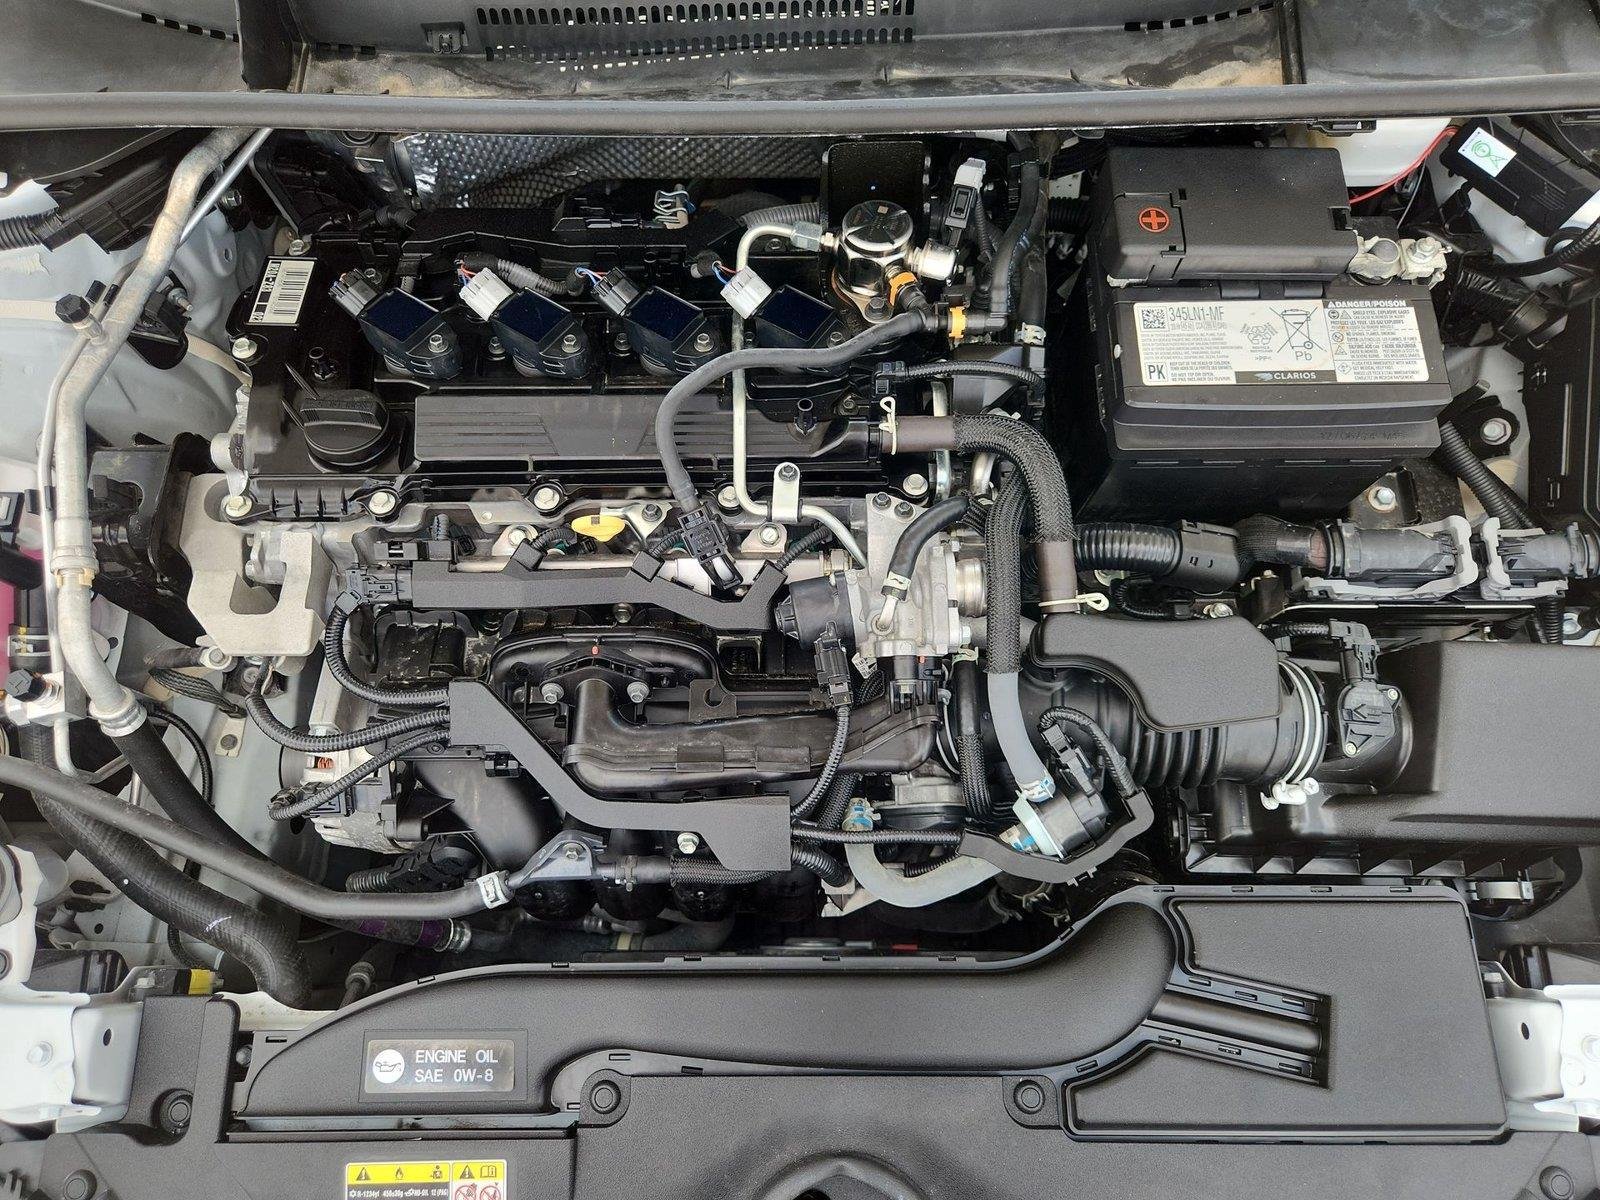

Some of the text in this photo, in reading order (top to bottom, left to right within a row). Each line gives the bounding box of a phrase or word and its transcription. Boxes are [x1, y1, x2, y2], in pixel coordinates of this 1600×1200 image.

[1335, 300, 1407, 308] DANGER/POISON
[1168, 306, 1225, 322] 345LN1-MF
[1295, 350, 1313, 361] Pb
[1147, 364, 1166, 380] PK
[1273, 372, 1317, 380] CLARIOS
[415, 1049, 499, 1063] ENGINE OIL
[414, 1068, 494, 1082] SAE 0W-8
